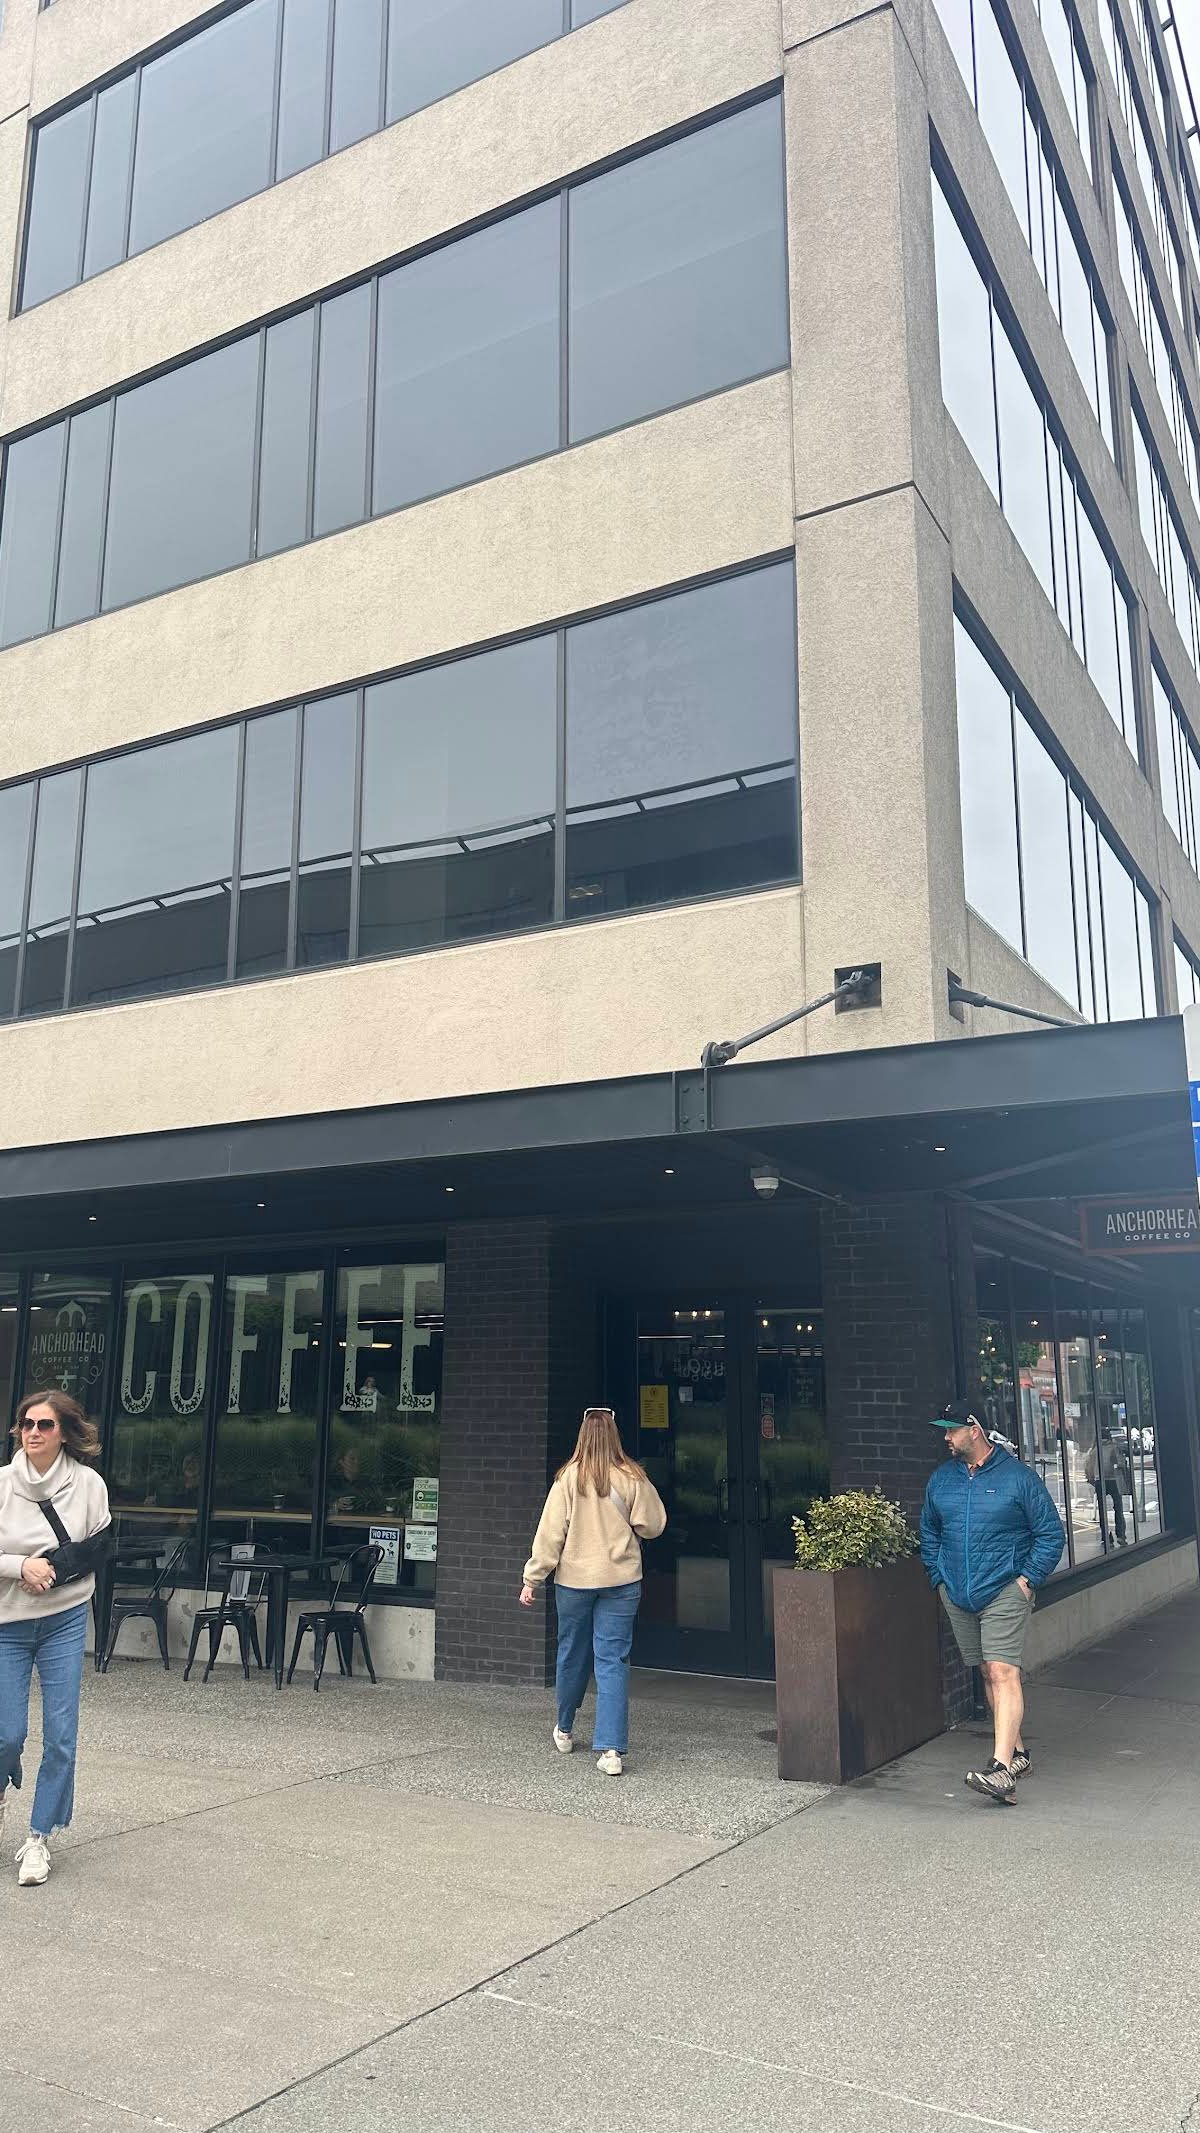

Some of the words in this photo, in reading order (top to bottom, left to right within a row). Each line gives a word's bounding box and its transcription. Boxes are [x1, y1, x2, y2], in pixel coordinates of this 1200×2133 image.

[1106, 1208, 1200, 1235] ANCHORHEA
[1124, 1233, 1170, 1241] COFFEE
[1174, 1231, 1191, 1239] CO
[31, 1331, 105, 1355] ANCHORHEAD
[120, 1266, 440, 1414] COFFEE
[42, 1356, 73, 1364] COFFEE
[371, 1530, 382, 1539] NO
[382, 1531, 397, 1540] PETS
